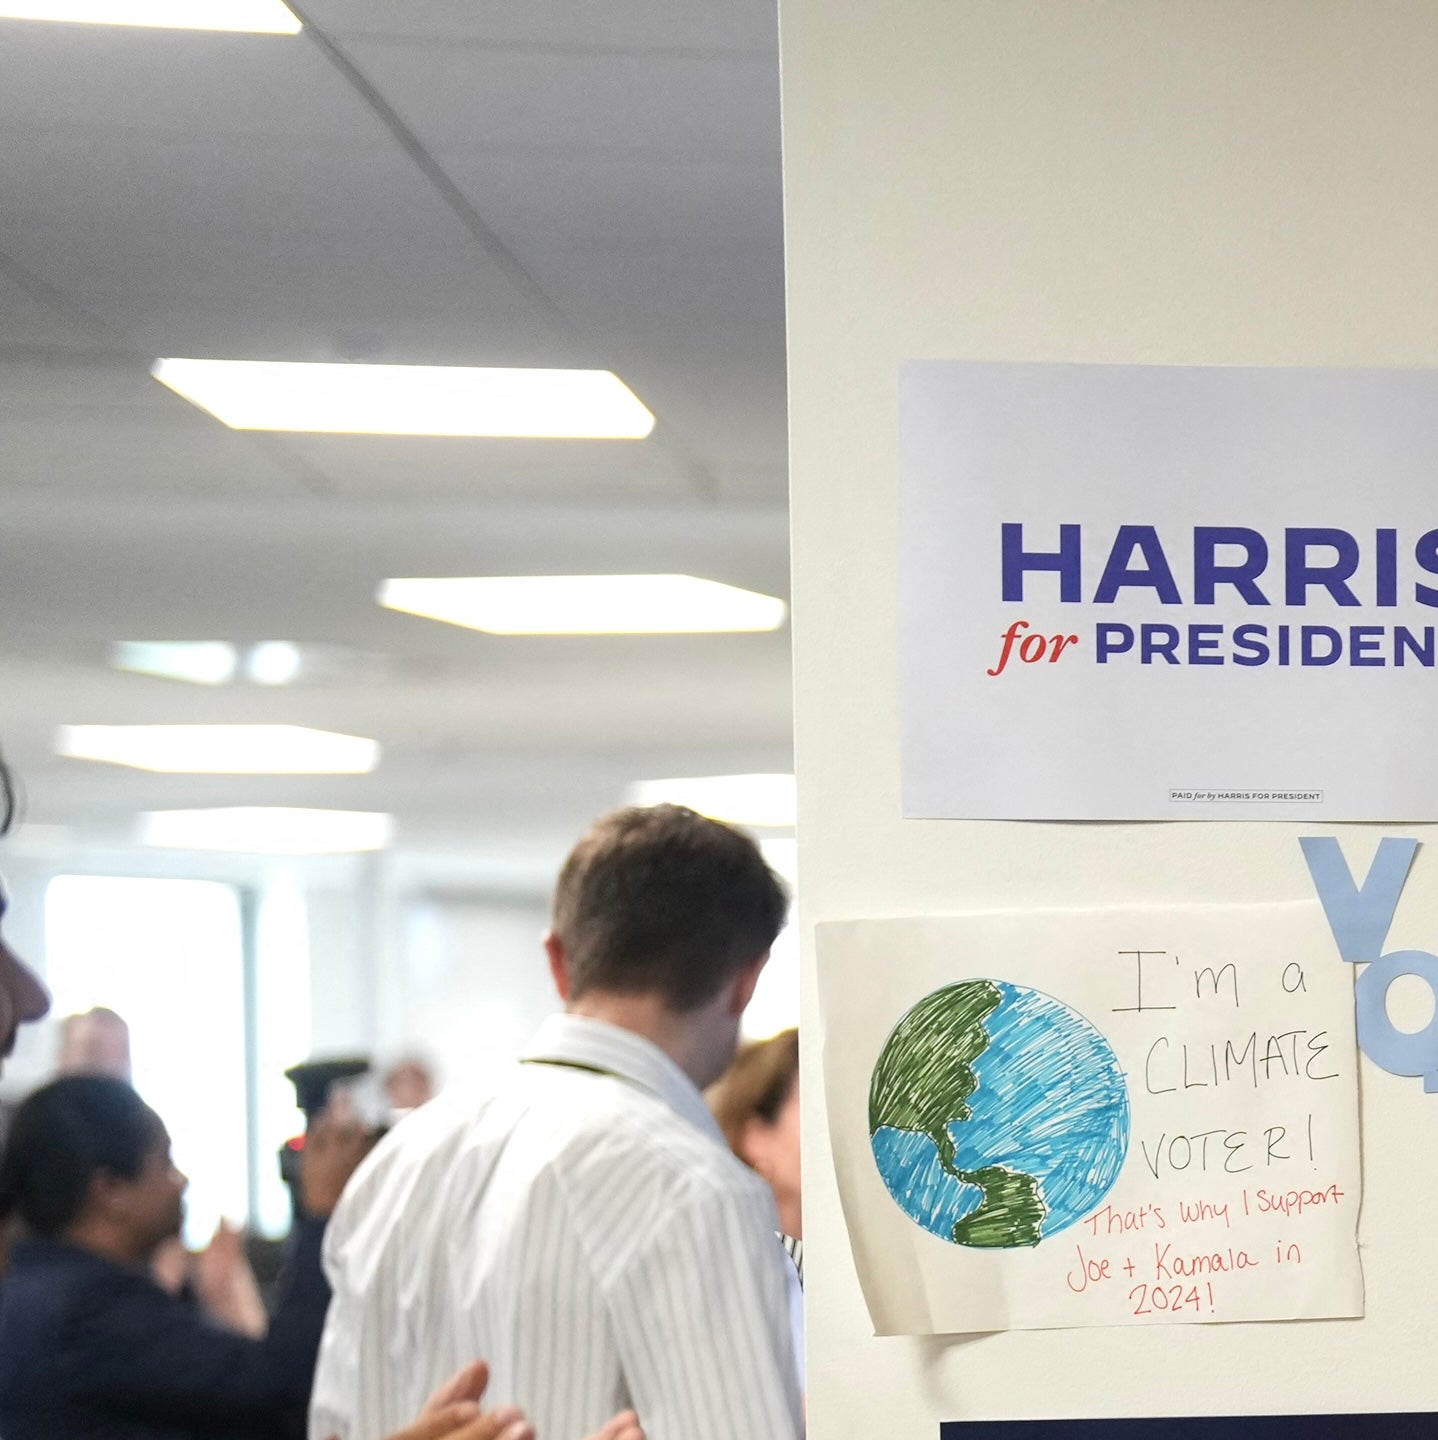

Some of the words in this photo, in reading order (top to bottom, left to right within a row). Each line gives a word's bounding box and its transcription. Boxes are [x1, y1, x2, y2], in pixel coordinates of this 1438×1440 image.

[987, 619, 1079, 677] for
[1193, 792, 1206, 801] for
[1207, 792, 1216, 801] by
[1217, 792, 1250, 800] HARRIS
[1112, 950, 1239, 1013] I'm
[1281, 962, 1307, 993] a
[1145, 1030, 1340, 1095] CLIMATE
[1141, 1113, 1318, 1180] VOTER!
[1084, 1203, 1166, 1236] That's
[1242, 1189, 1250, 1216] I
[1067, 1244, 1112, 1293] Joe
[1155, 1242, 1260, 1281] Kamala
[1276, 1240, 1302, 1264] in
[1128, 1281, 1216, 1316] 2024!
